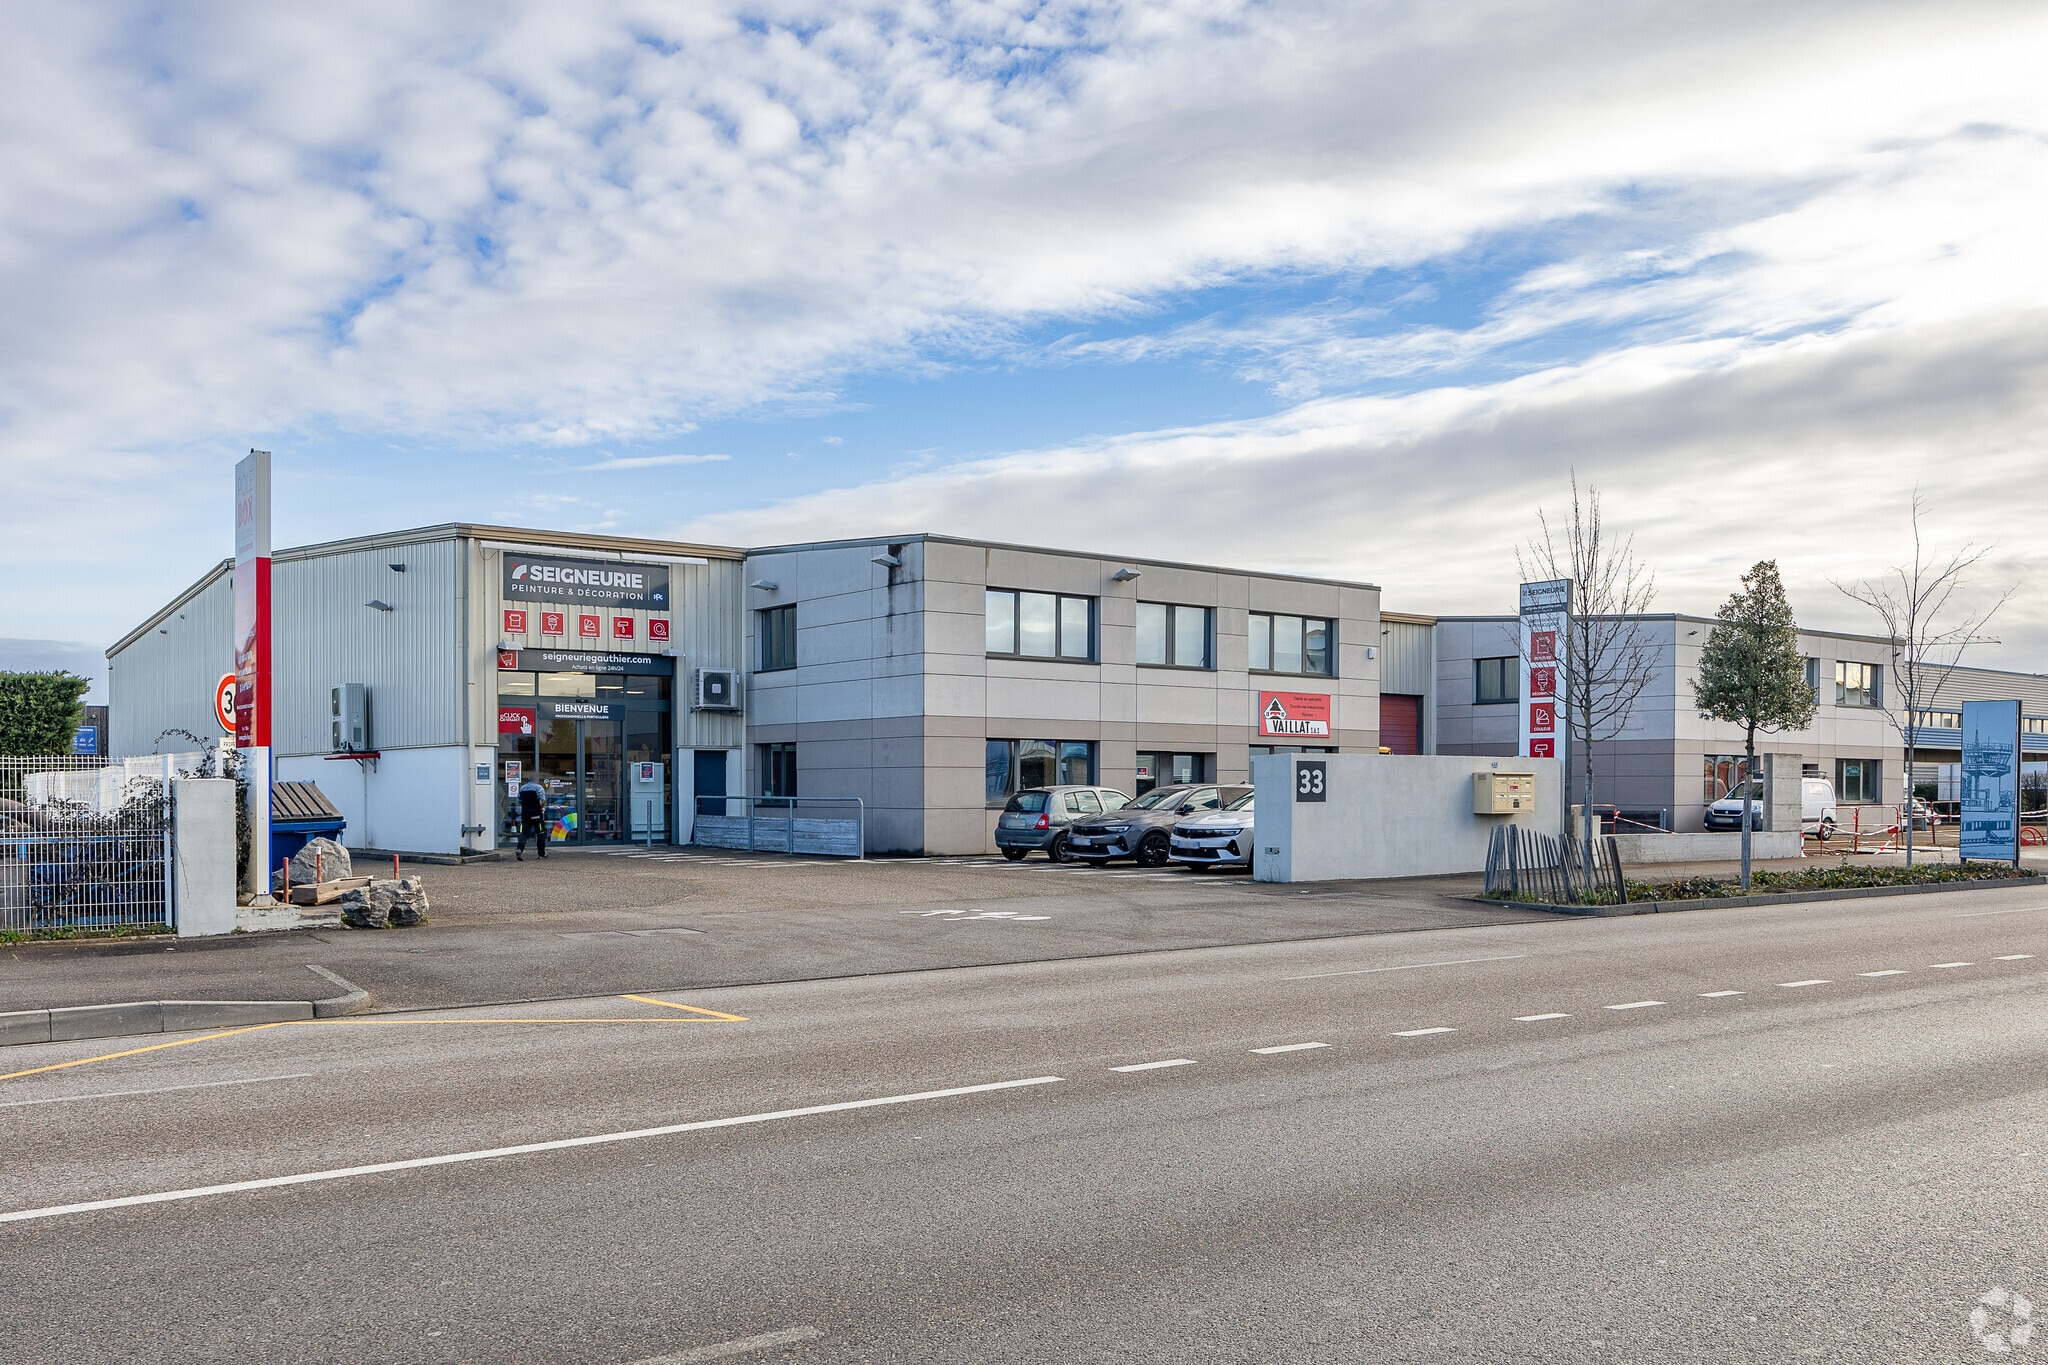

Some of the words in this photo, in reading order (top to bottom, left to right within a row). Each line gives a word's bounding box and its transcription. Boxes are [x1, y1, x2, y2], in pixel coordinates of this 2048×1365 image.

[237, 496, 253, 528] BOX
[530, 565, 643, 589] SEIGNEURIE
[511, 583, 564, 596] PEINTURE
[567, 588, 574, 596] &
[578, 587, 643, 601] DÉCORATION
[542, 651, 652, 664] seigneuriegauthier.com
[595, 664, 607, 672] ligne
[555, 704, 609, 714] BIENVENUE
[1272, 719, 1310, 734] VAILLAT
[1299, 769, 1324, 794] 33
